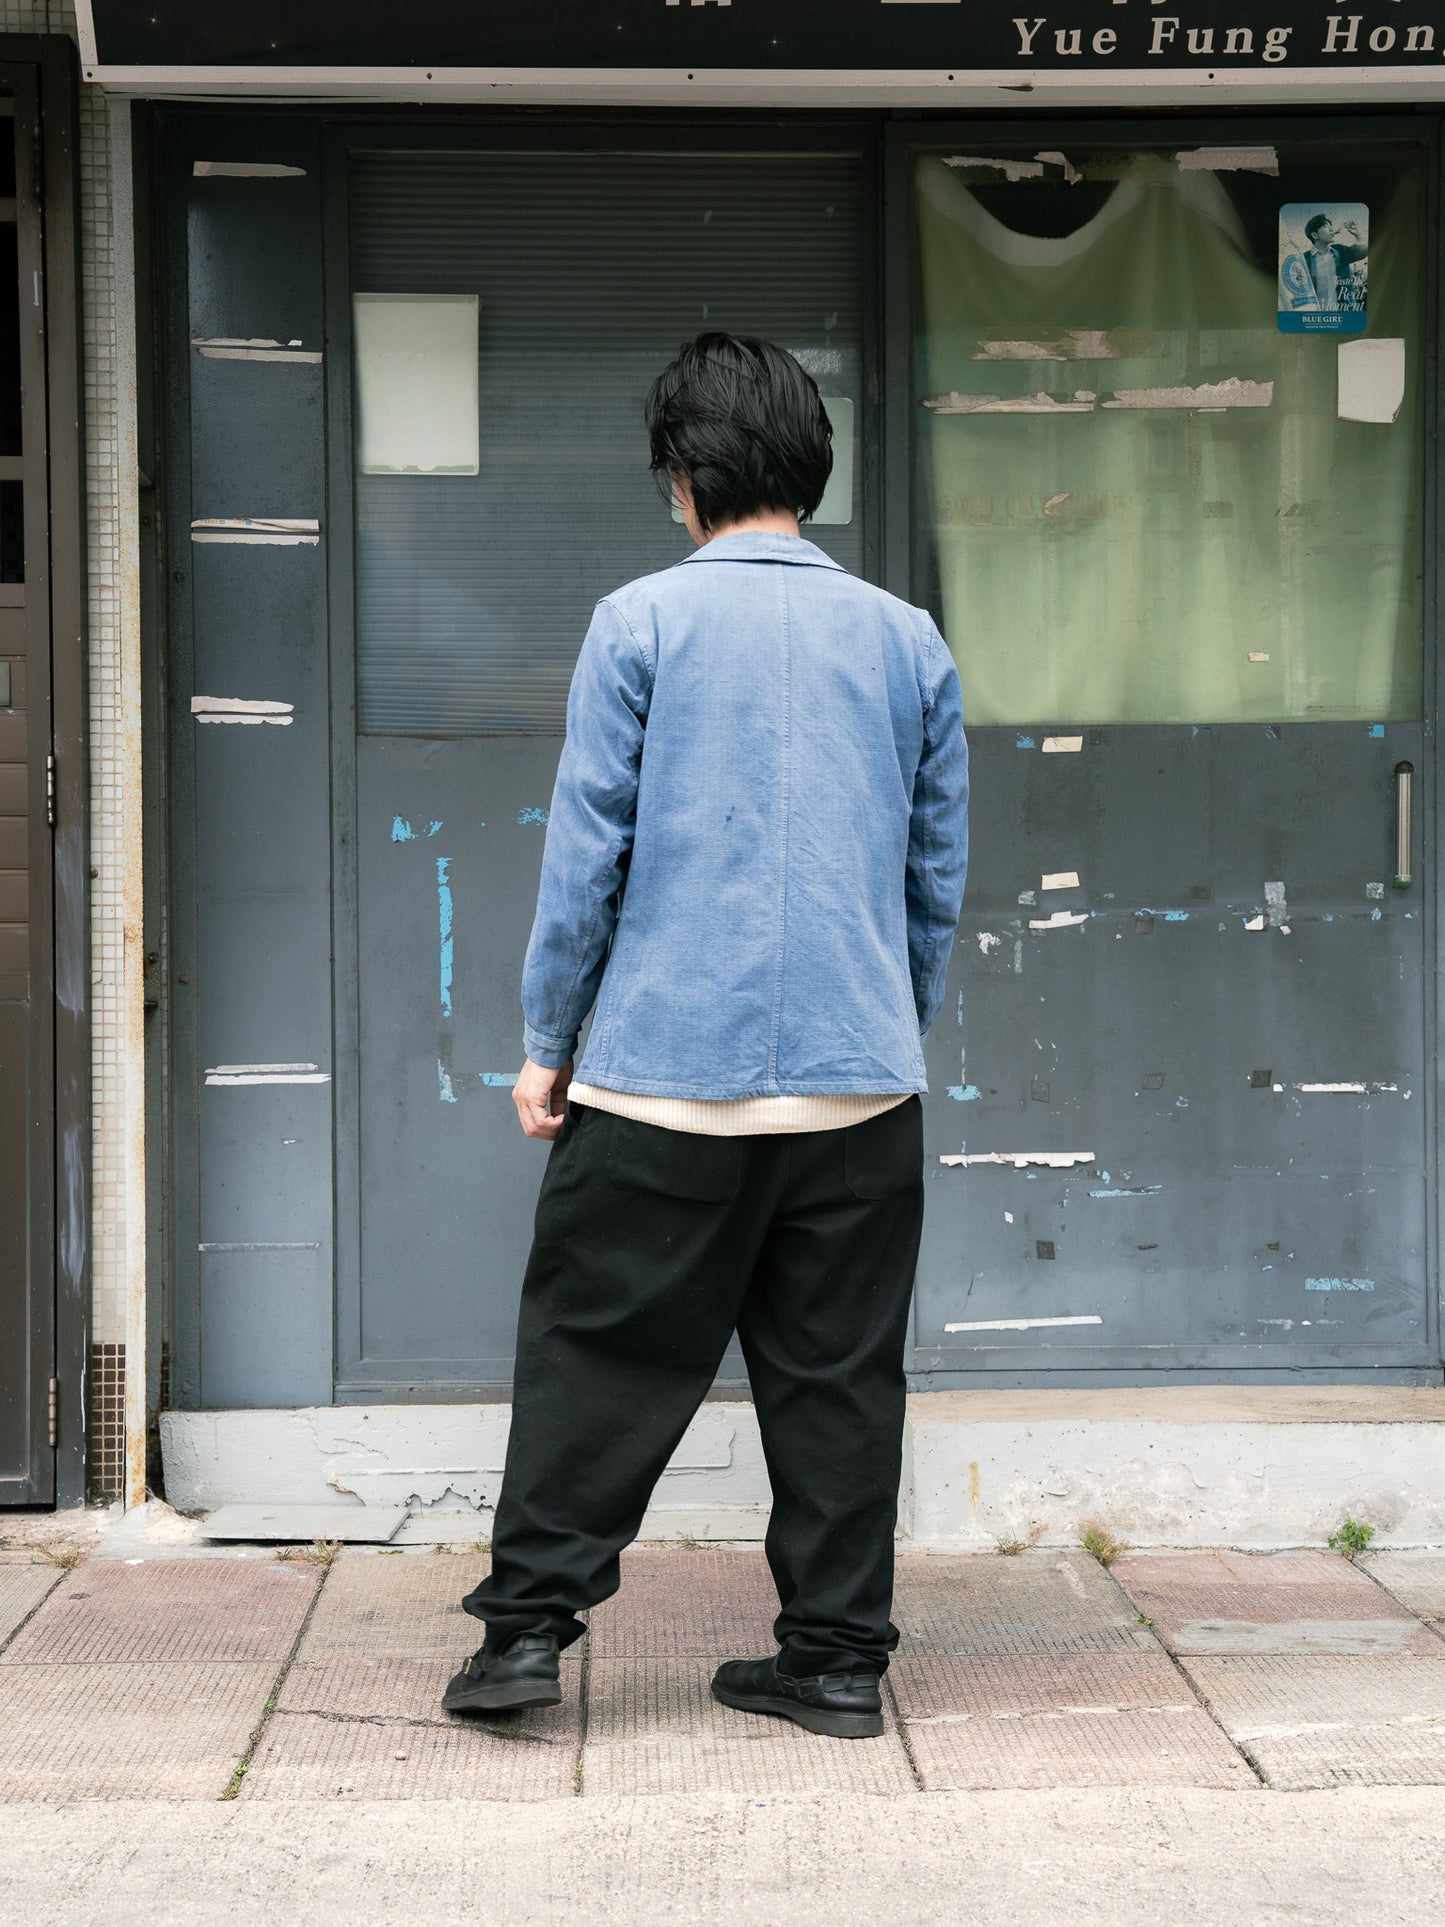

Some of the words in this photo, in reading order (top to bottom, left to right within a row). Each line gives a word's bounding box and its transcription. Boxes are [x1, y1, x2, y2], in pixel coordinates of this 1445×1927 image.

[1012, 18, 1117, 55] Yue
[1147, 17, 1293, 63] Fung
[1321, 15, 1445, 57] Hon
[1337, 286, 1365, 300] Real
[1319, 298, 1364, 312] Moment
[1302, 315, 1322, 323] BLUE
[1323, 315, 1342, 323] GIRL
